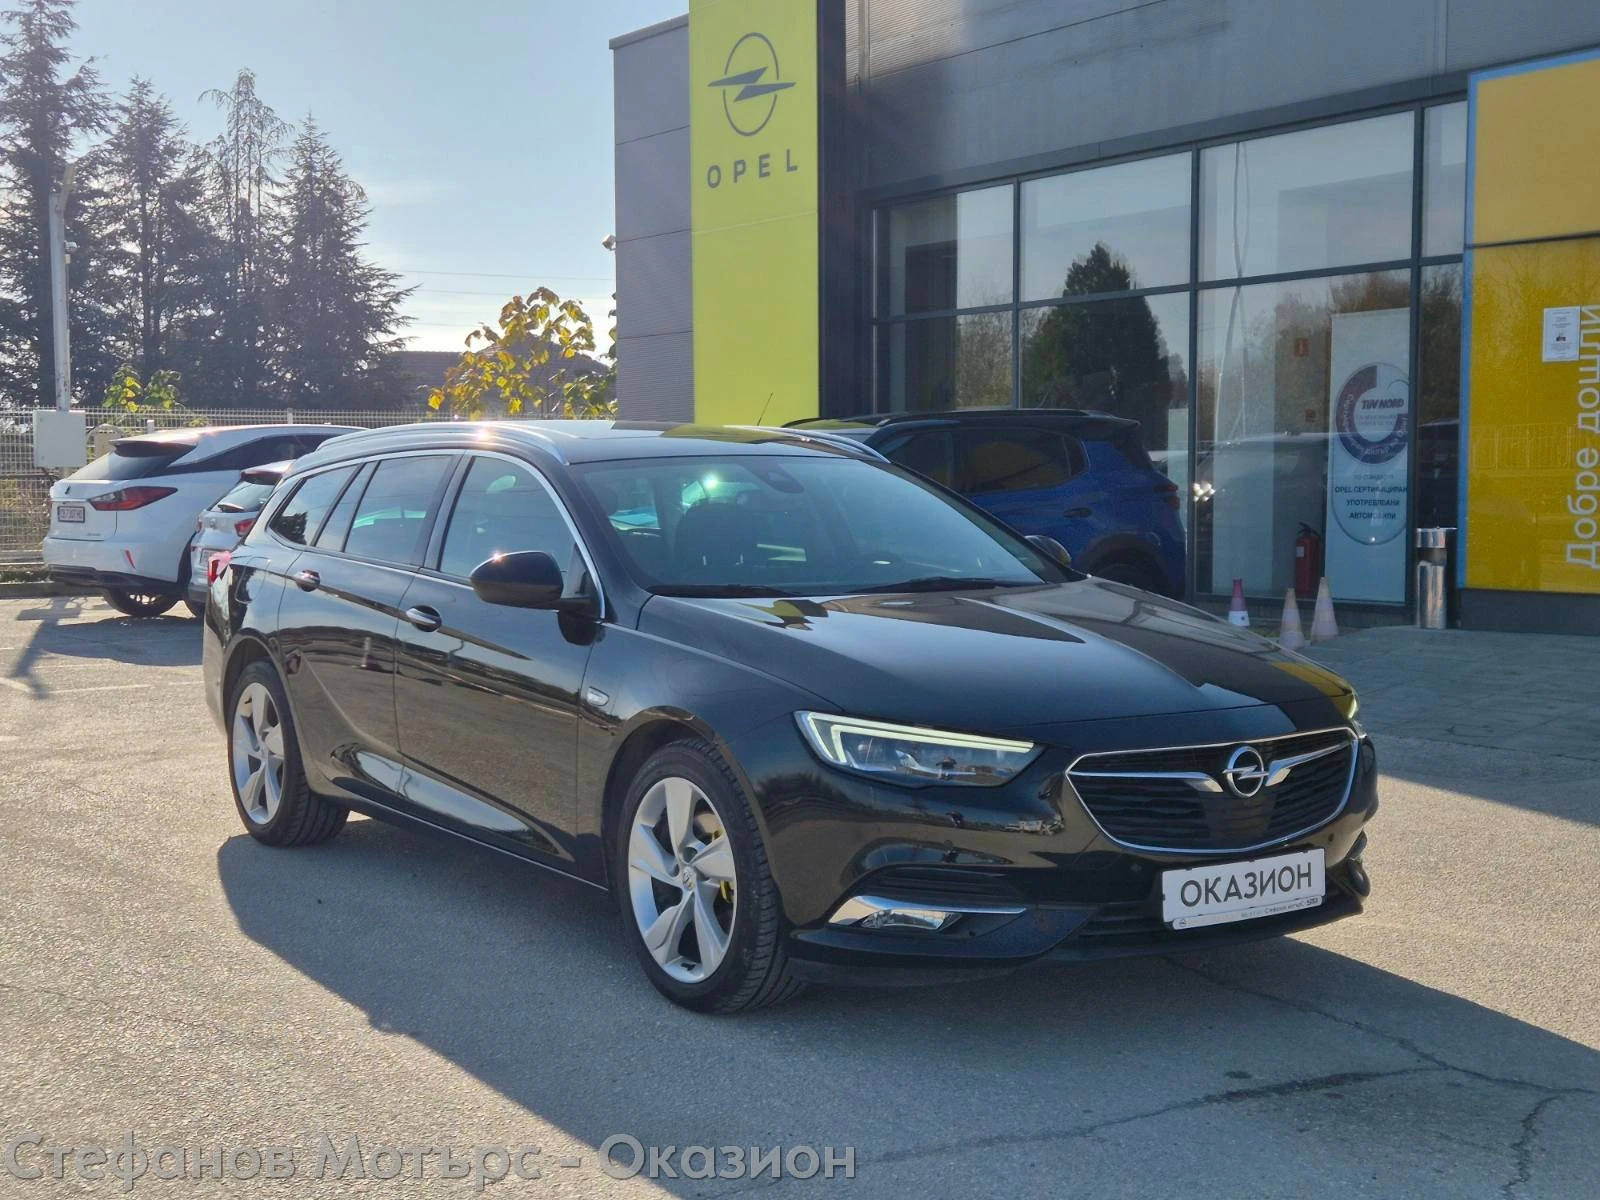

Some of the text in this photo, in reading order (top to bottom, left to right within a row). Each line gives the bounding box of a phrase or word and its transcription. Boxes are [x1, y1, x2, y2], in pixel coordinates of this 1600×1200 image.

[707, 148, 798, 189] OPEL
[1566, 447, 1600, 571] Добре
[1180, 862, 1312, 907] ОКАЗИОН
